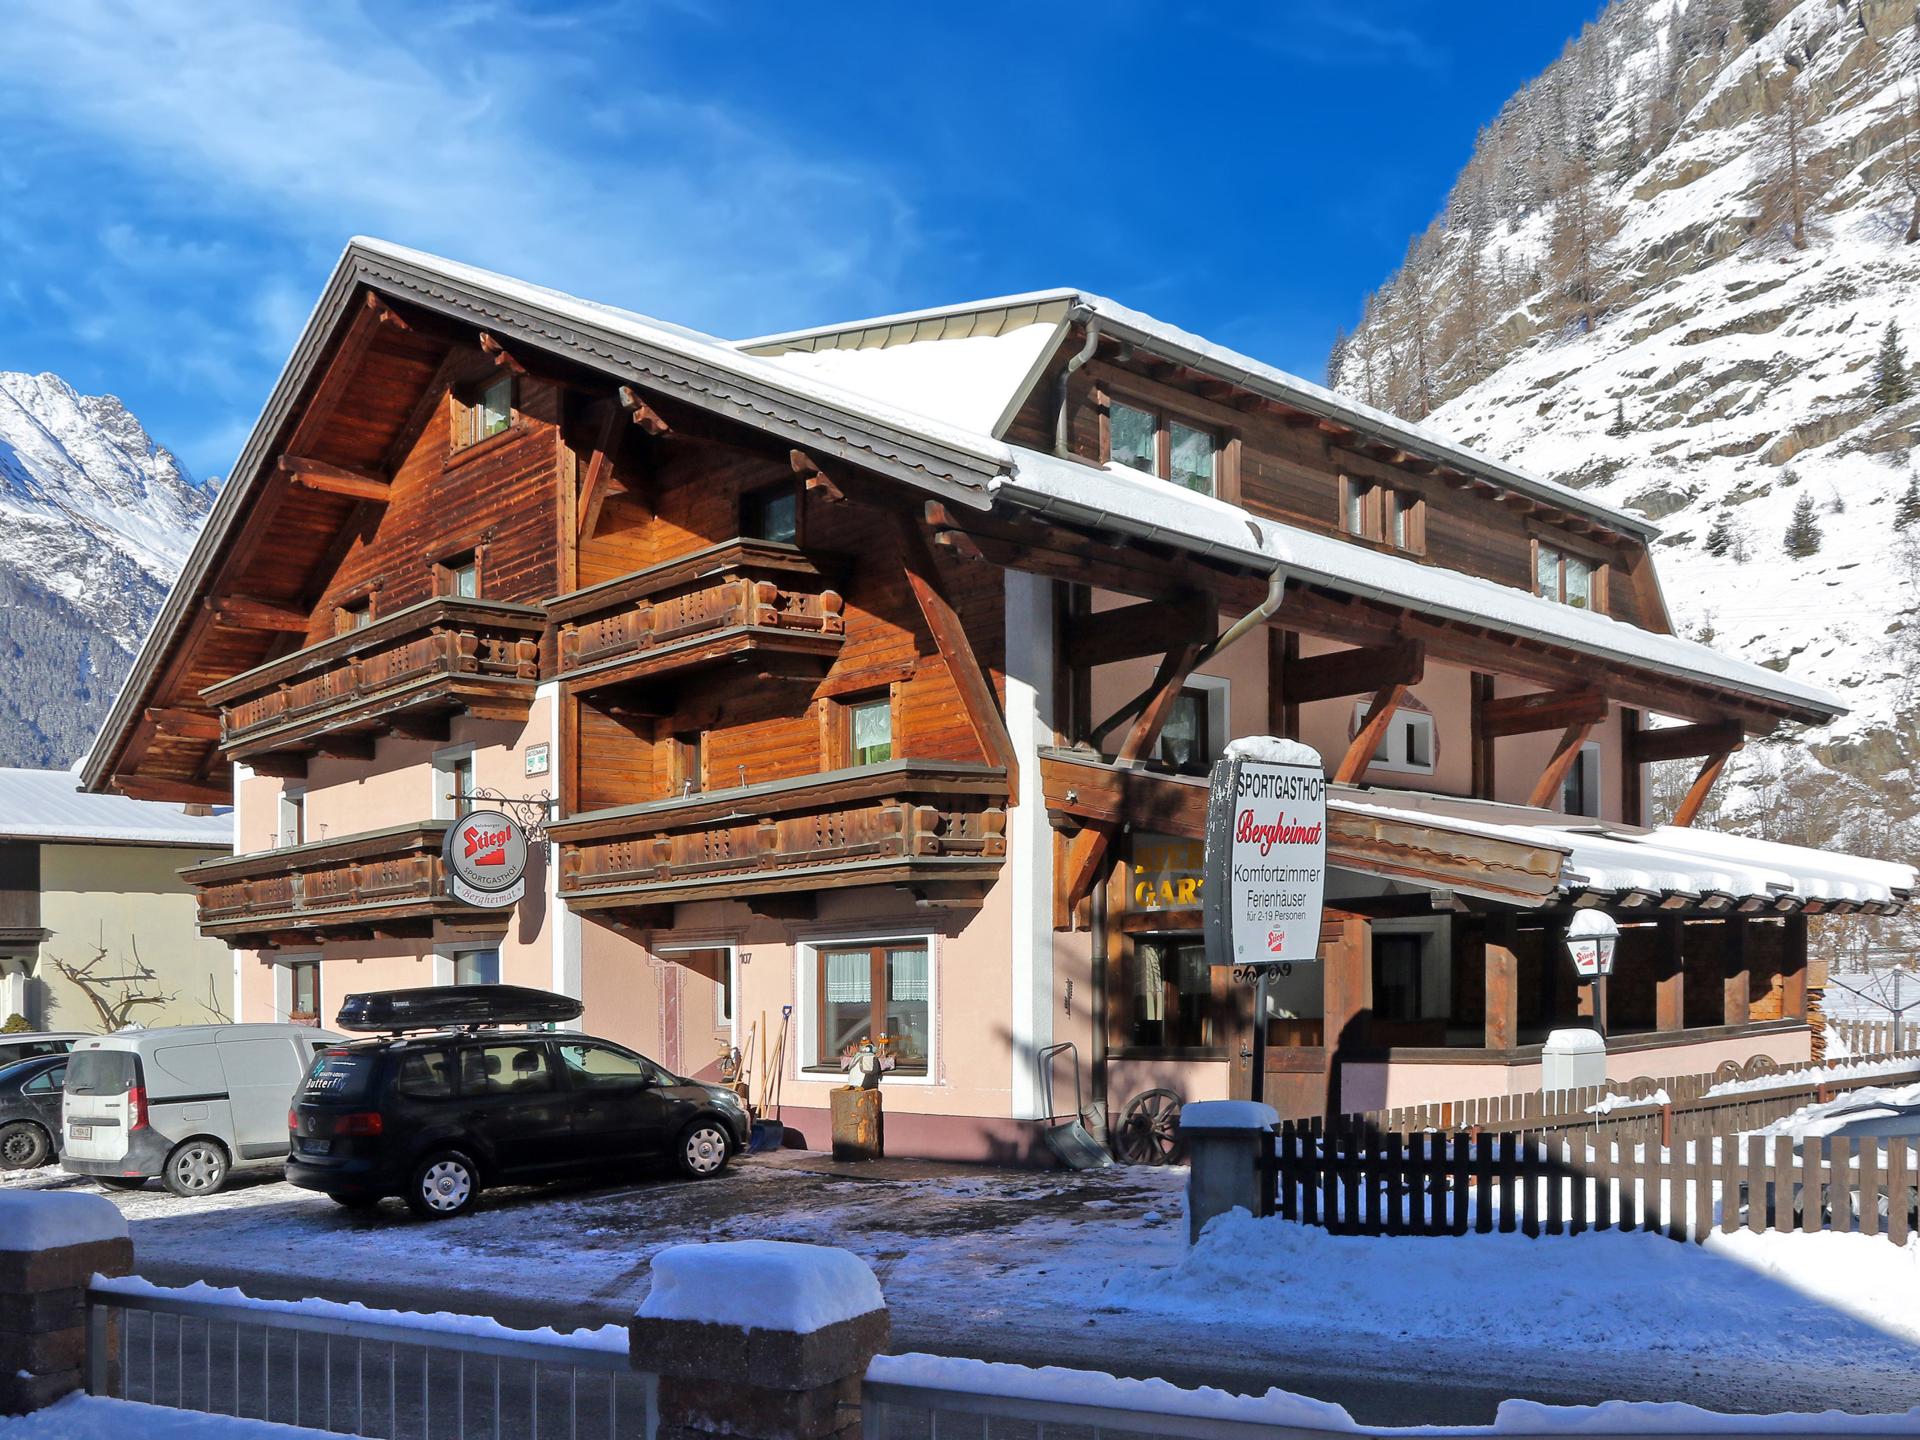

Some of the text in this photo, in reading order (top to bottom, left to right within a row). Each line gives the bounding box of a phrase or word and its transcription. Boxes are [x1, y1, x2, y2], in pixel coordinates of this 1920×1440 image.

[1237, 772, 1325, 802] SPORTGASTHOF
[464, 824, 512, 859] Stiegl
[1236, 809, 1322, 857] Bergheimat
[463, 864, 518, 884] SPORTGASTHOF
[1234, 864, 1321, 883] Komfortzimmer
[462, 888, 517, 905] Bergheimat
[1135, 878, 1204, 907] GAR
[1247, 889, 1307, 908] Ferienhäuser
[1246, 910, 1306, 921] für 2-19 Personen
[305, 1077, 346, 1092] Butterfly
